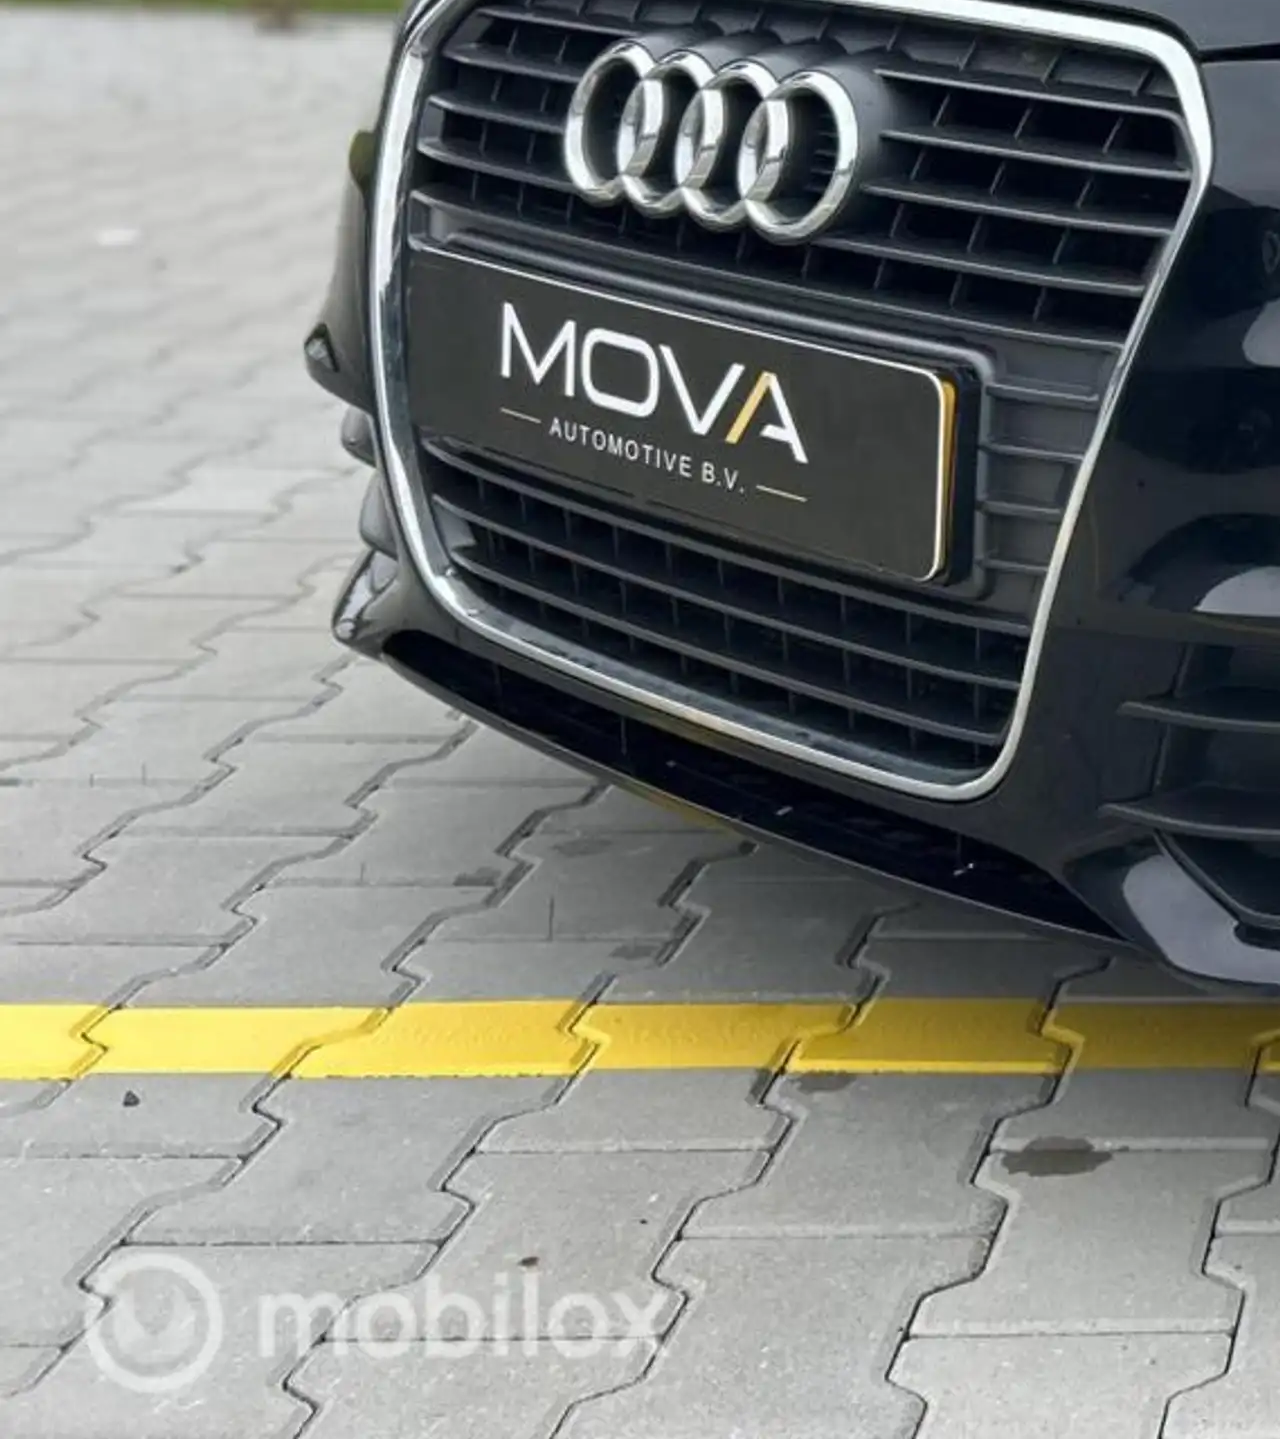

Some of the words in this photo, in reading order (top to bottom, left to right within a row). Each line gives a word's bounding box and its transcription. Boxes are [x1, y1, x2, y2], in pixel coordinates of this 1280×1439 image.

[500, 301, 809, 464] MOVA
[548, 417, 693, 479] AUTOMOTIVE
[701, 462, 745, 494] B.V.
